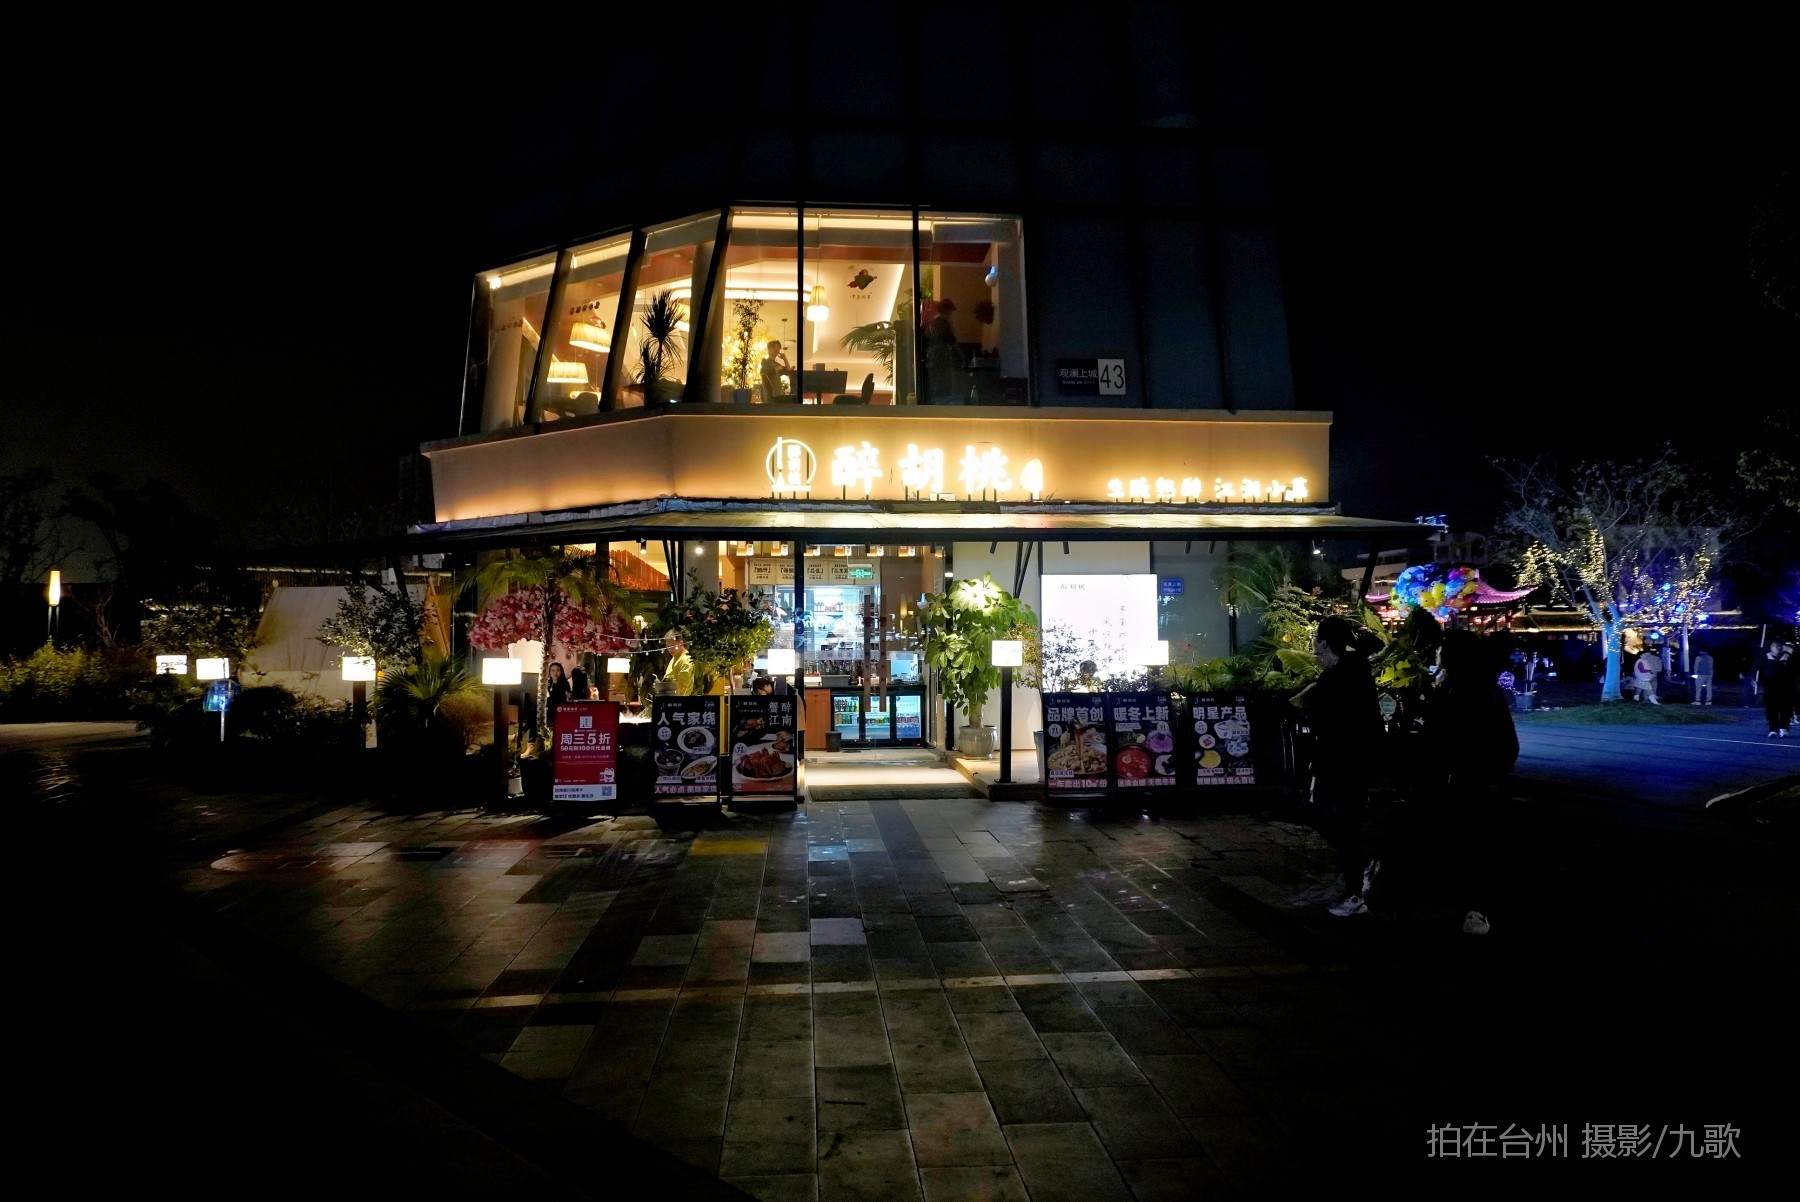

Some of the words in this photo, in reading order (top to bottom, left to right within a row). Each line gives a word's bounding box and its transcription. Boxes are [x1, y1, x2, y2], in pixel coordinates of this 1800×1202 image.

[1100, 364, 1125, 389] 43
[831, 440, 1013, 494] 醉胡桃
[657, 711, 716, 726] 人气家烧
[1047, 706, 1104, 721] 品牌首创
[1113, 706, 1169, 721] 暖冬上新
[1193, 706, 1247, 720] 明星产品
[560, 732, 611, 745] 周三5折
